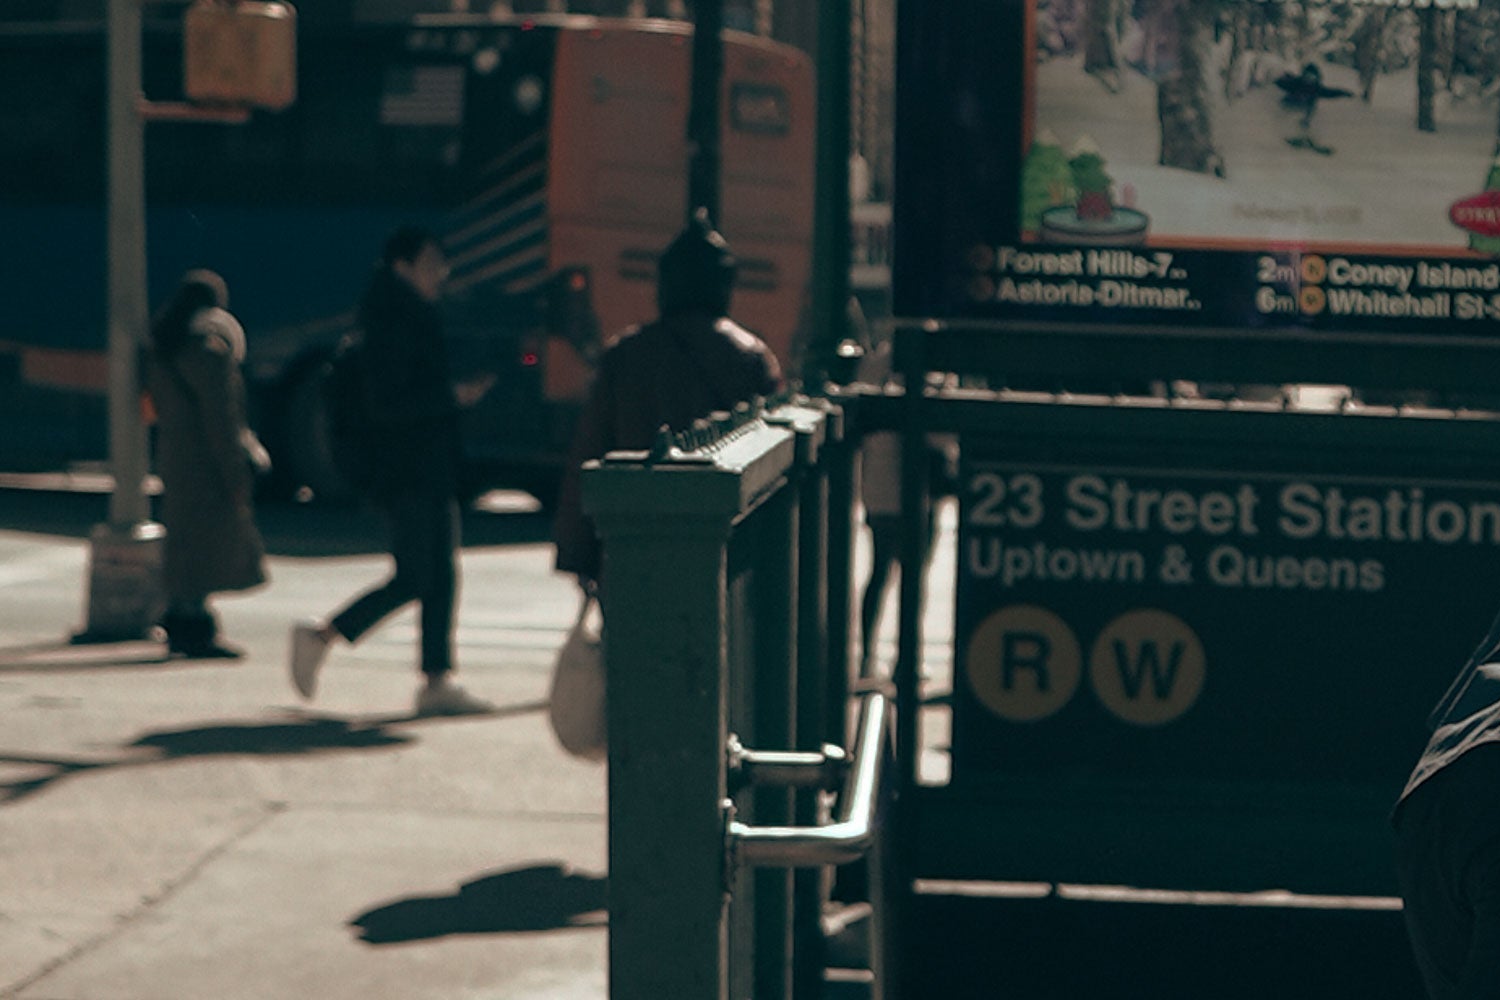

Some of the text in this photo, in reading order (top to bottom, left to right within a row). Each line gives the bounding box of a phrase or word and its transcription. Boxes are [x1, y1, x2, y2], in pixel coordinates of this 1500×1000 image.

[998, 247, 1083, 277] Forest
[1256, 255, 1295, 282] 2m
[1328, 257, 1414, 292] Coney
[1256, 286, 1295, 314] 6m
[1327, 287, 1451, 319] Whitehall
[968, 473, 1044, 528] 23
[1064, 476, 1259, 536] Street
[968, 536, 1386, 592] Uptown & Queens
[1001, 631, 1187, 699] R W
